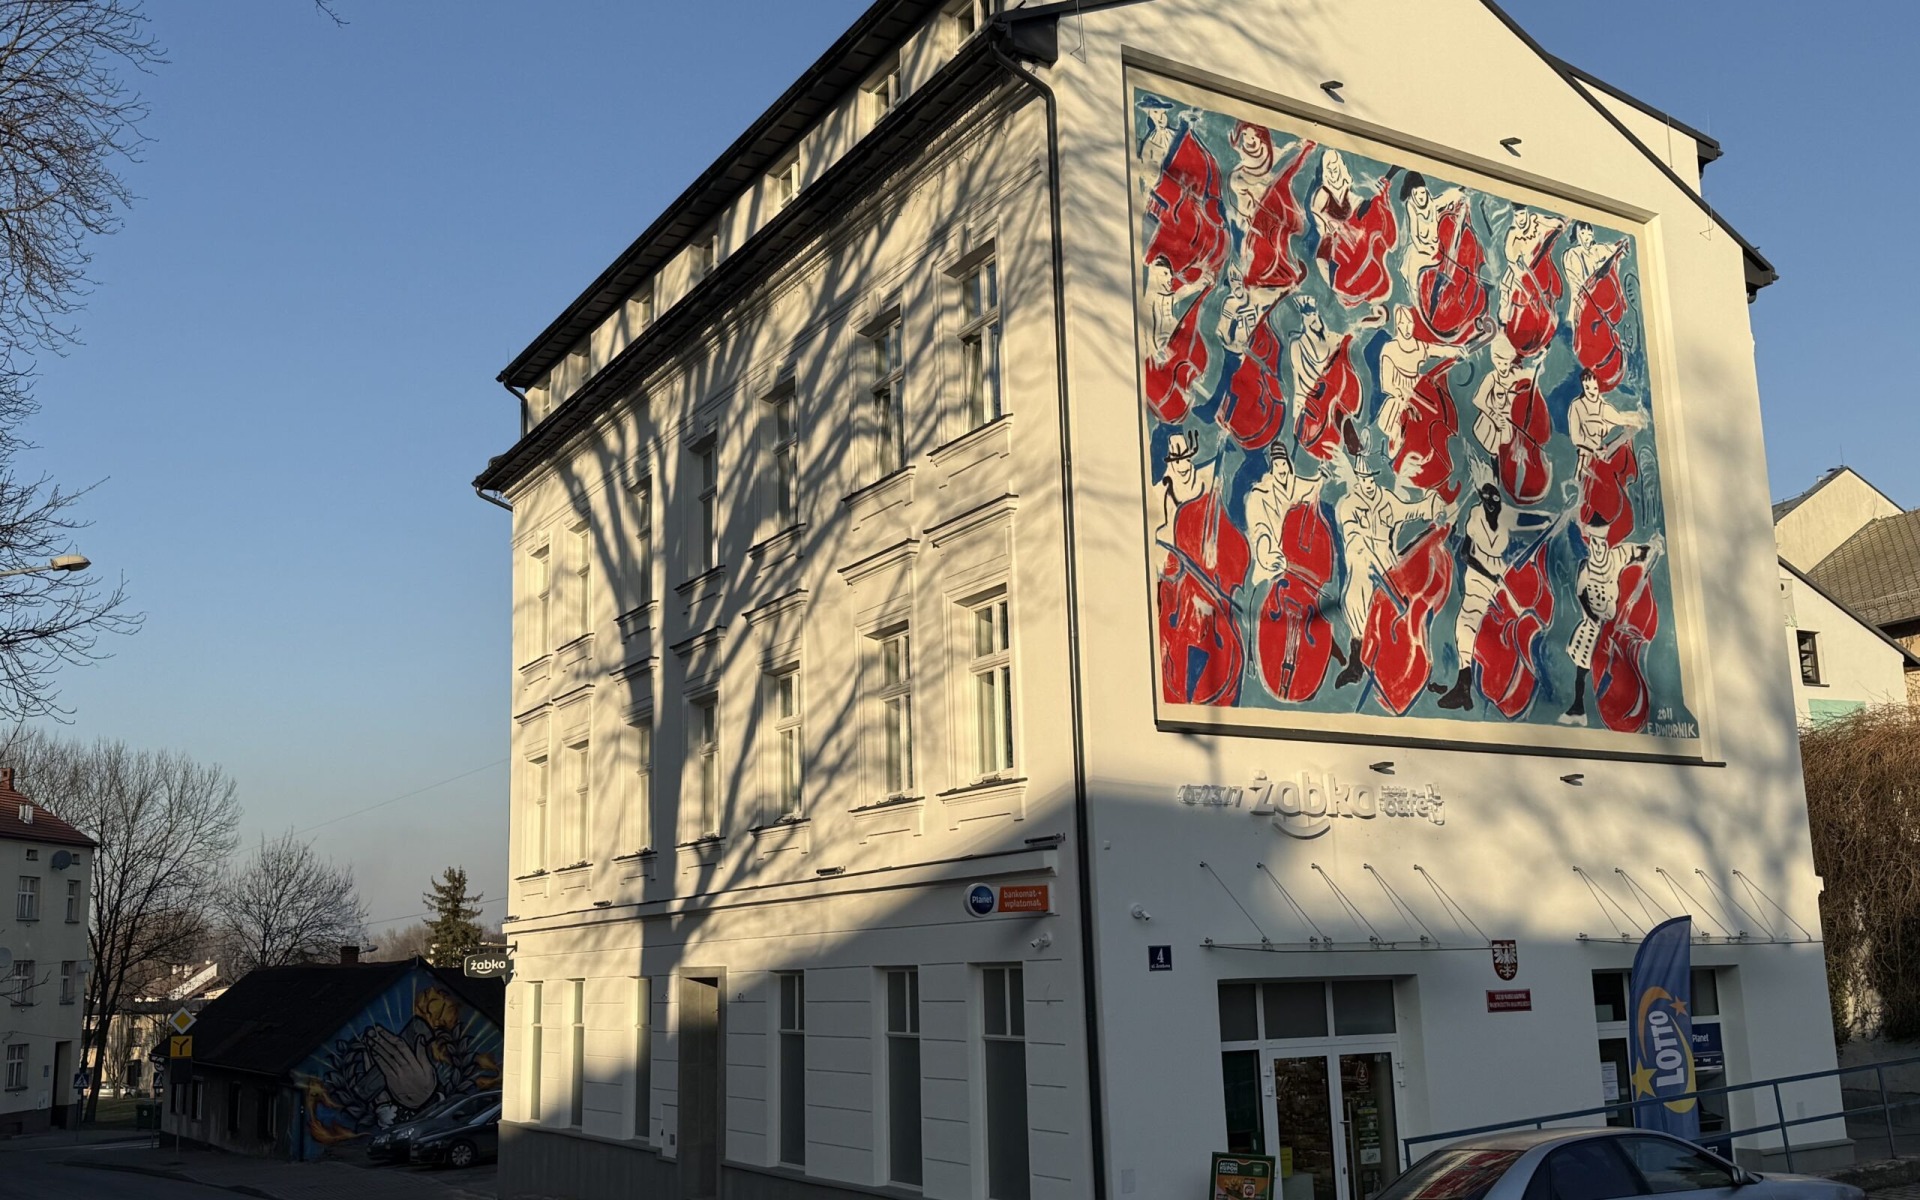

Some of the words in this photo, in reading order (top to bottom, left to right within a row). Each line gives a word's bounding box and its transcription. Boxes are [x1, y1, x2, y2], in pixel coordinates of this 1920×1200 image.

[1657, 707, 1673, 720] 2011
[1250, 770, 1377, 819] żabka
[972, 896, 992, 904] Planet
[1157, 948, 1165, 963] 4
[471, 959, 506, 970] żabka
[1692, 1034, 1709, 1043] Planet
[1649, 1010, 1685, 1088] LOTTO
